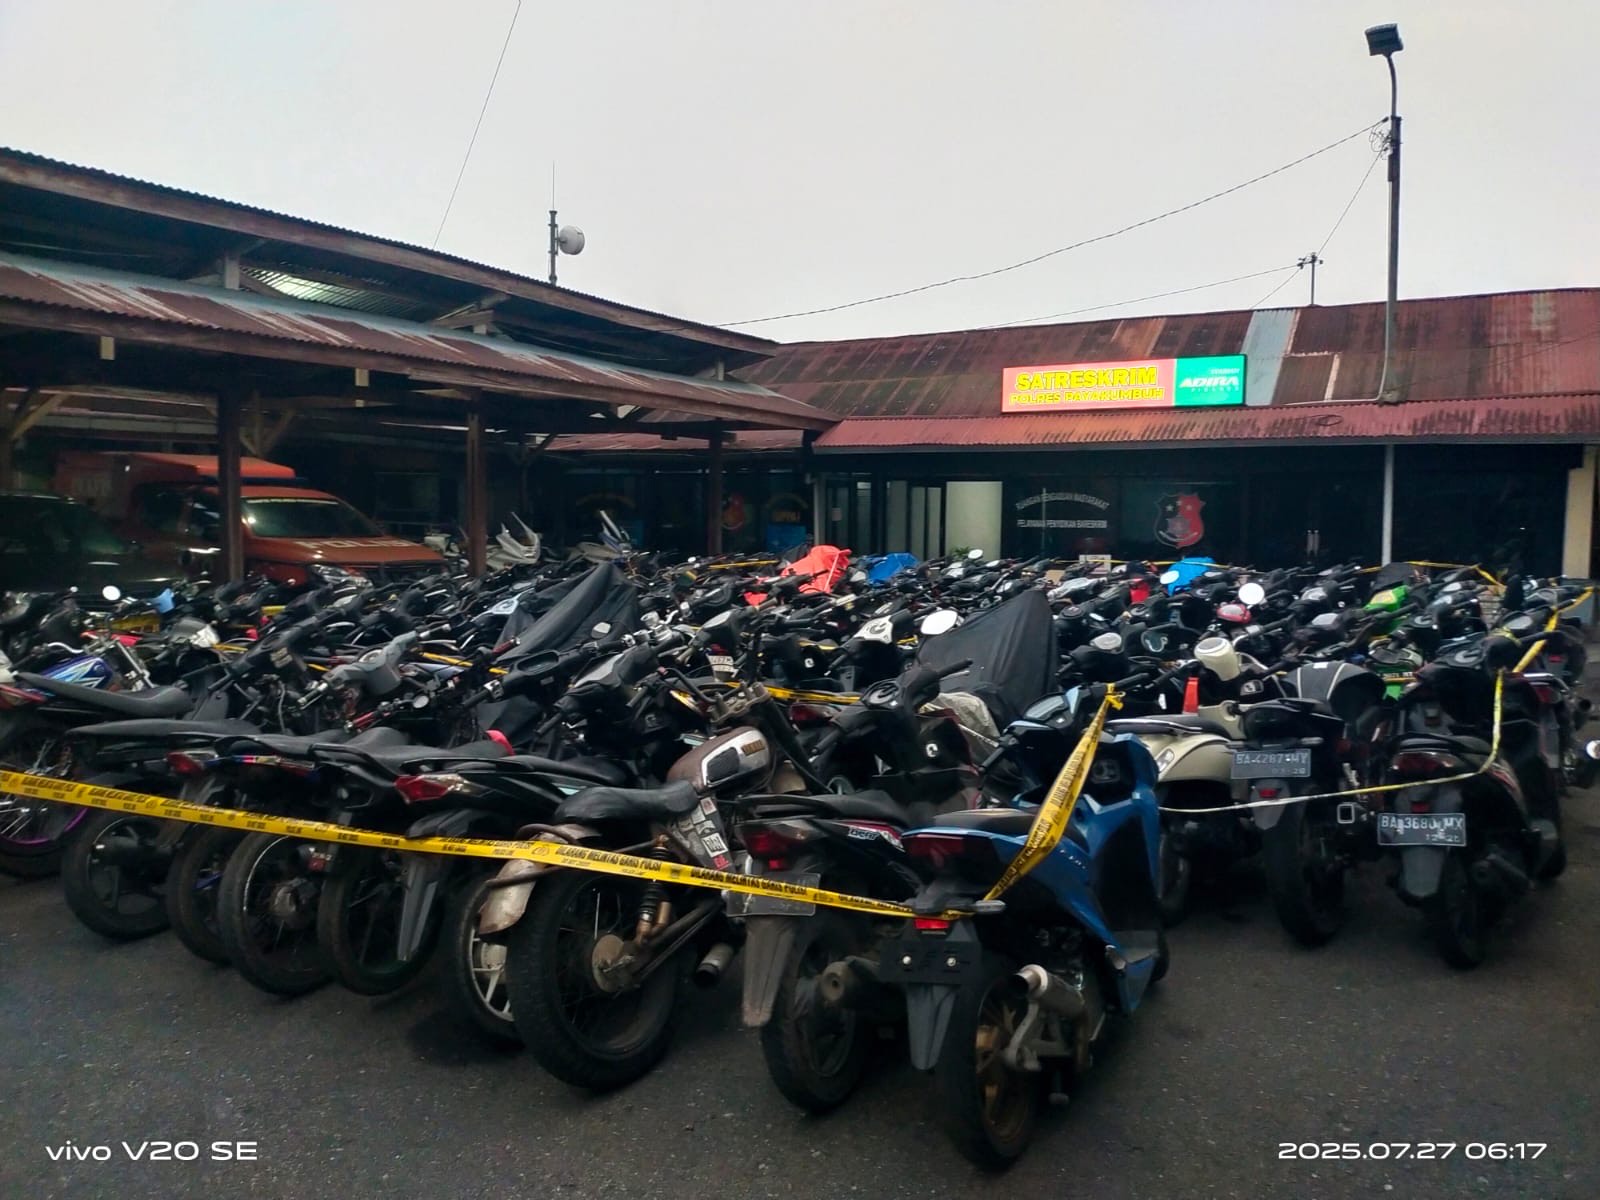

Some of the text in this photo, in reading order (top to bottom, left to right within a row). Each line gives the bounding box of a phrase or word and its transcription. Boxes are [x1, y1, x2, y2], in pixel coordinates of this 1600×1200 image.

[1016, 367, 1157, 391] SATRESKRIM
[1010, 388, 1163, 405] POLRES PAYAKUMBUH
[295, 539, 421, 549] POLISI
[1381, 815, 1397, 828] BA
[587, 849, 618, 864] MELINTAS
[619, 856, 640, 868] GARIS
[640, 859, 661, 871] POLISI
